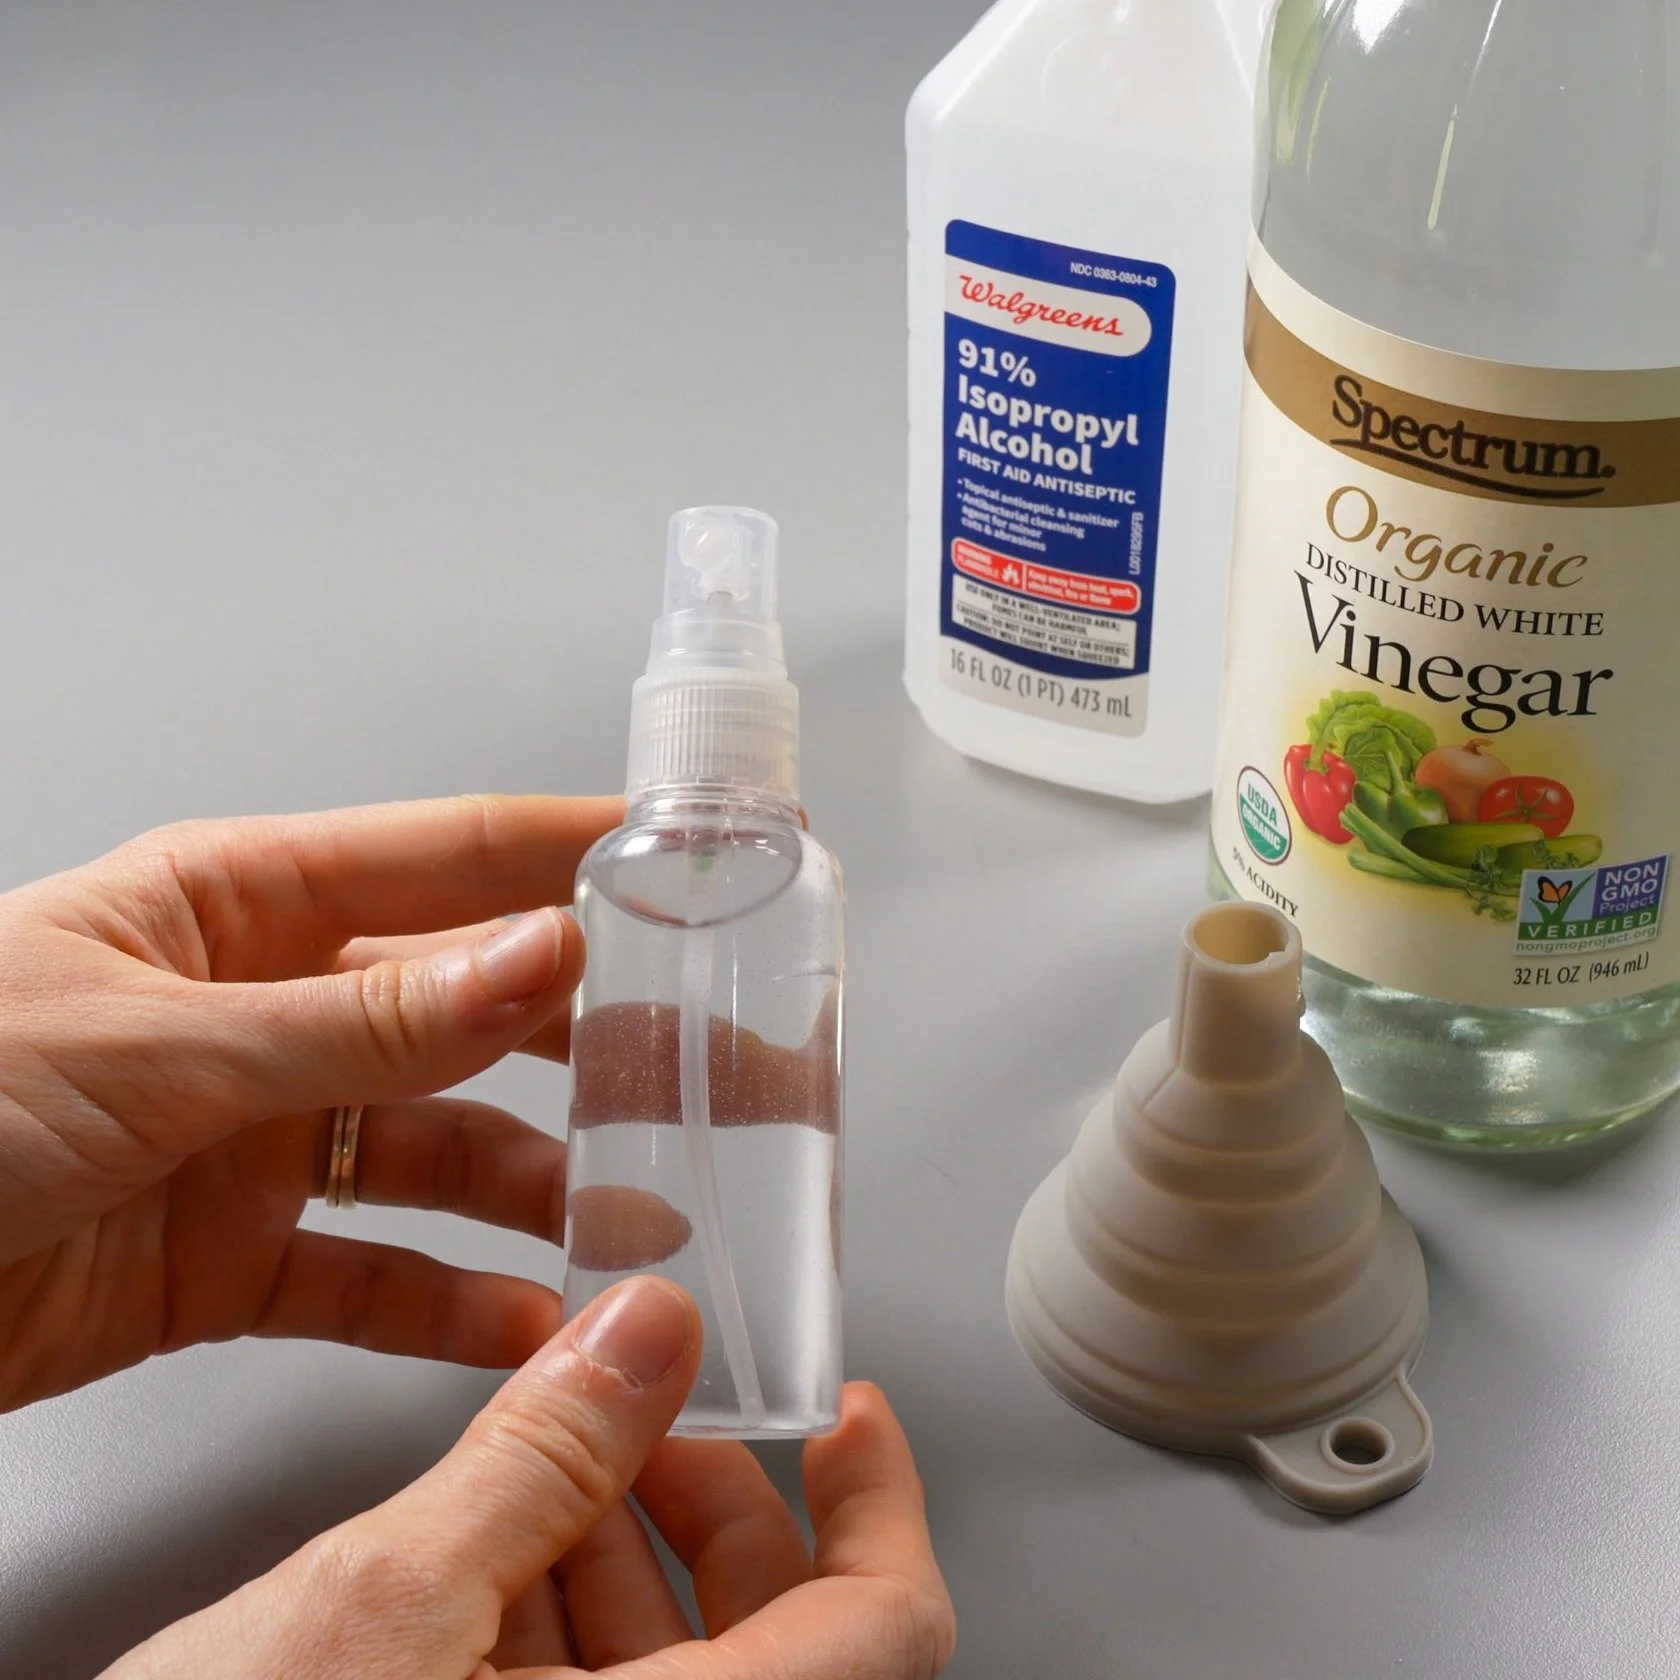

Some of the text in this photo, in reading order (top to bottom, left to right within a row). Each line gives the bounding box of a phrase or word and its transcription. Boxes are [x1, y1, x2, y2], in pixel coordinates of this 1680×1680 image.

[1070, 262, 1092, 276] NDC
[960, 275, 1124, 336] Walgreens
[958, 338, 1036, 388] 91%
[959, 374, 1139, 448] Isopropyl
[955, 412, 1094, 475] Alcohol
[958, 448, 1136, 504] FIRST AID ANTISEPTIC
[962, 506, 990, 524] agent
[1008, 521, 1042, 538] minor
[963, 493, 1085, 539] Antibacterial cleansing
[964, 478, 1120, 528] Topical antiseptic & sanitizer
[961, 517, 1046, 552] cuts & abrasions
[1325, 485, 1588, 589] Organic
[1306, 542, 1604, 637] DISTILLED WHITE
[1293, 569, 1614, 734] Vinegar
[951, 648, 1132, 718] 16 FL OZ (1 PT) 473 mL
[1243, 802, 1281, 851] ORGANIC
[1248, 783, 1278, 826] USDA
[1233, 846, 1299, 918] 5% ACIDITY
[1602, 879, 1658, 901] GMO
[1605, 862, 1660, 886] NON
[1528, 911, 1652, 938] VERIFIED
[1600, 894, 1655, 914] Project
[1516, 927, 1656, 953] nongmoproject.org
[1514, 951, 1649, 985] 32 FL OZ (946 mL)
